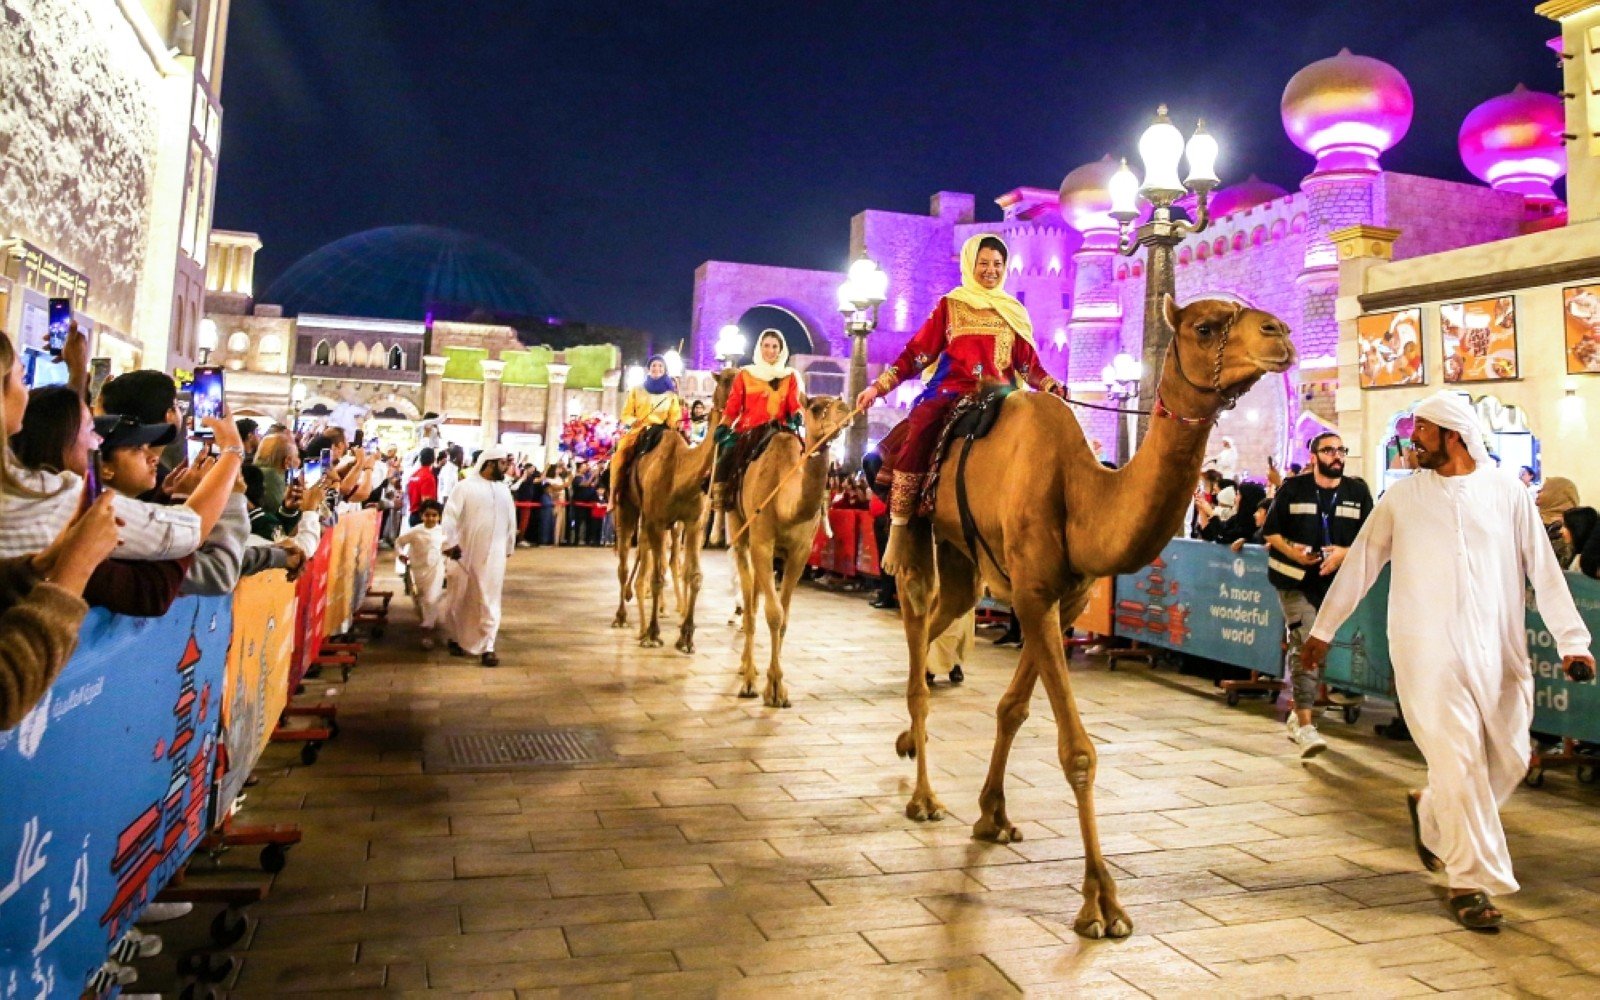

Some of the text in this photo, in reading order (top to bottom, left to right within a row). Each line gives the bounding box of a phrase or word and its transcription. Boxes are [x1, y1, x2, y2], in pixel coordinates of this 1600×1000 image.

[1220, 582, 1262, 603] A more
[1209, 604, 1269, 627] wonderful
[1222, 627, 1256, 646] world
[1535, 686, 1569, 712] rld
